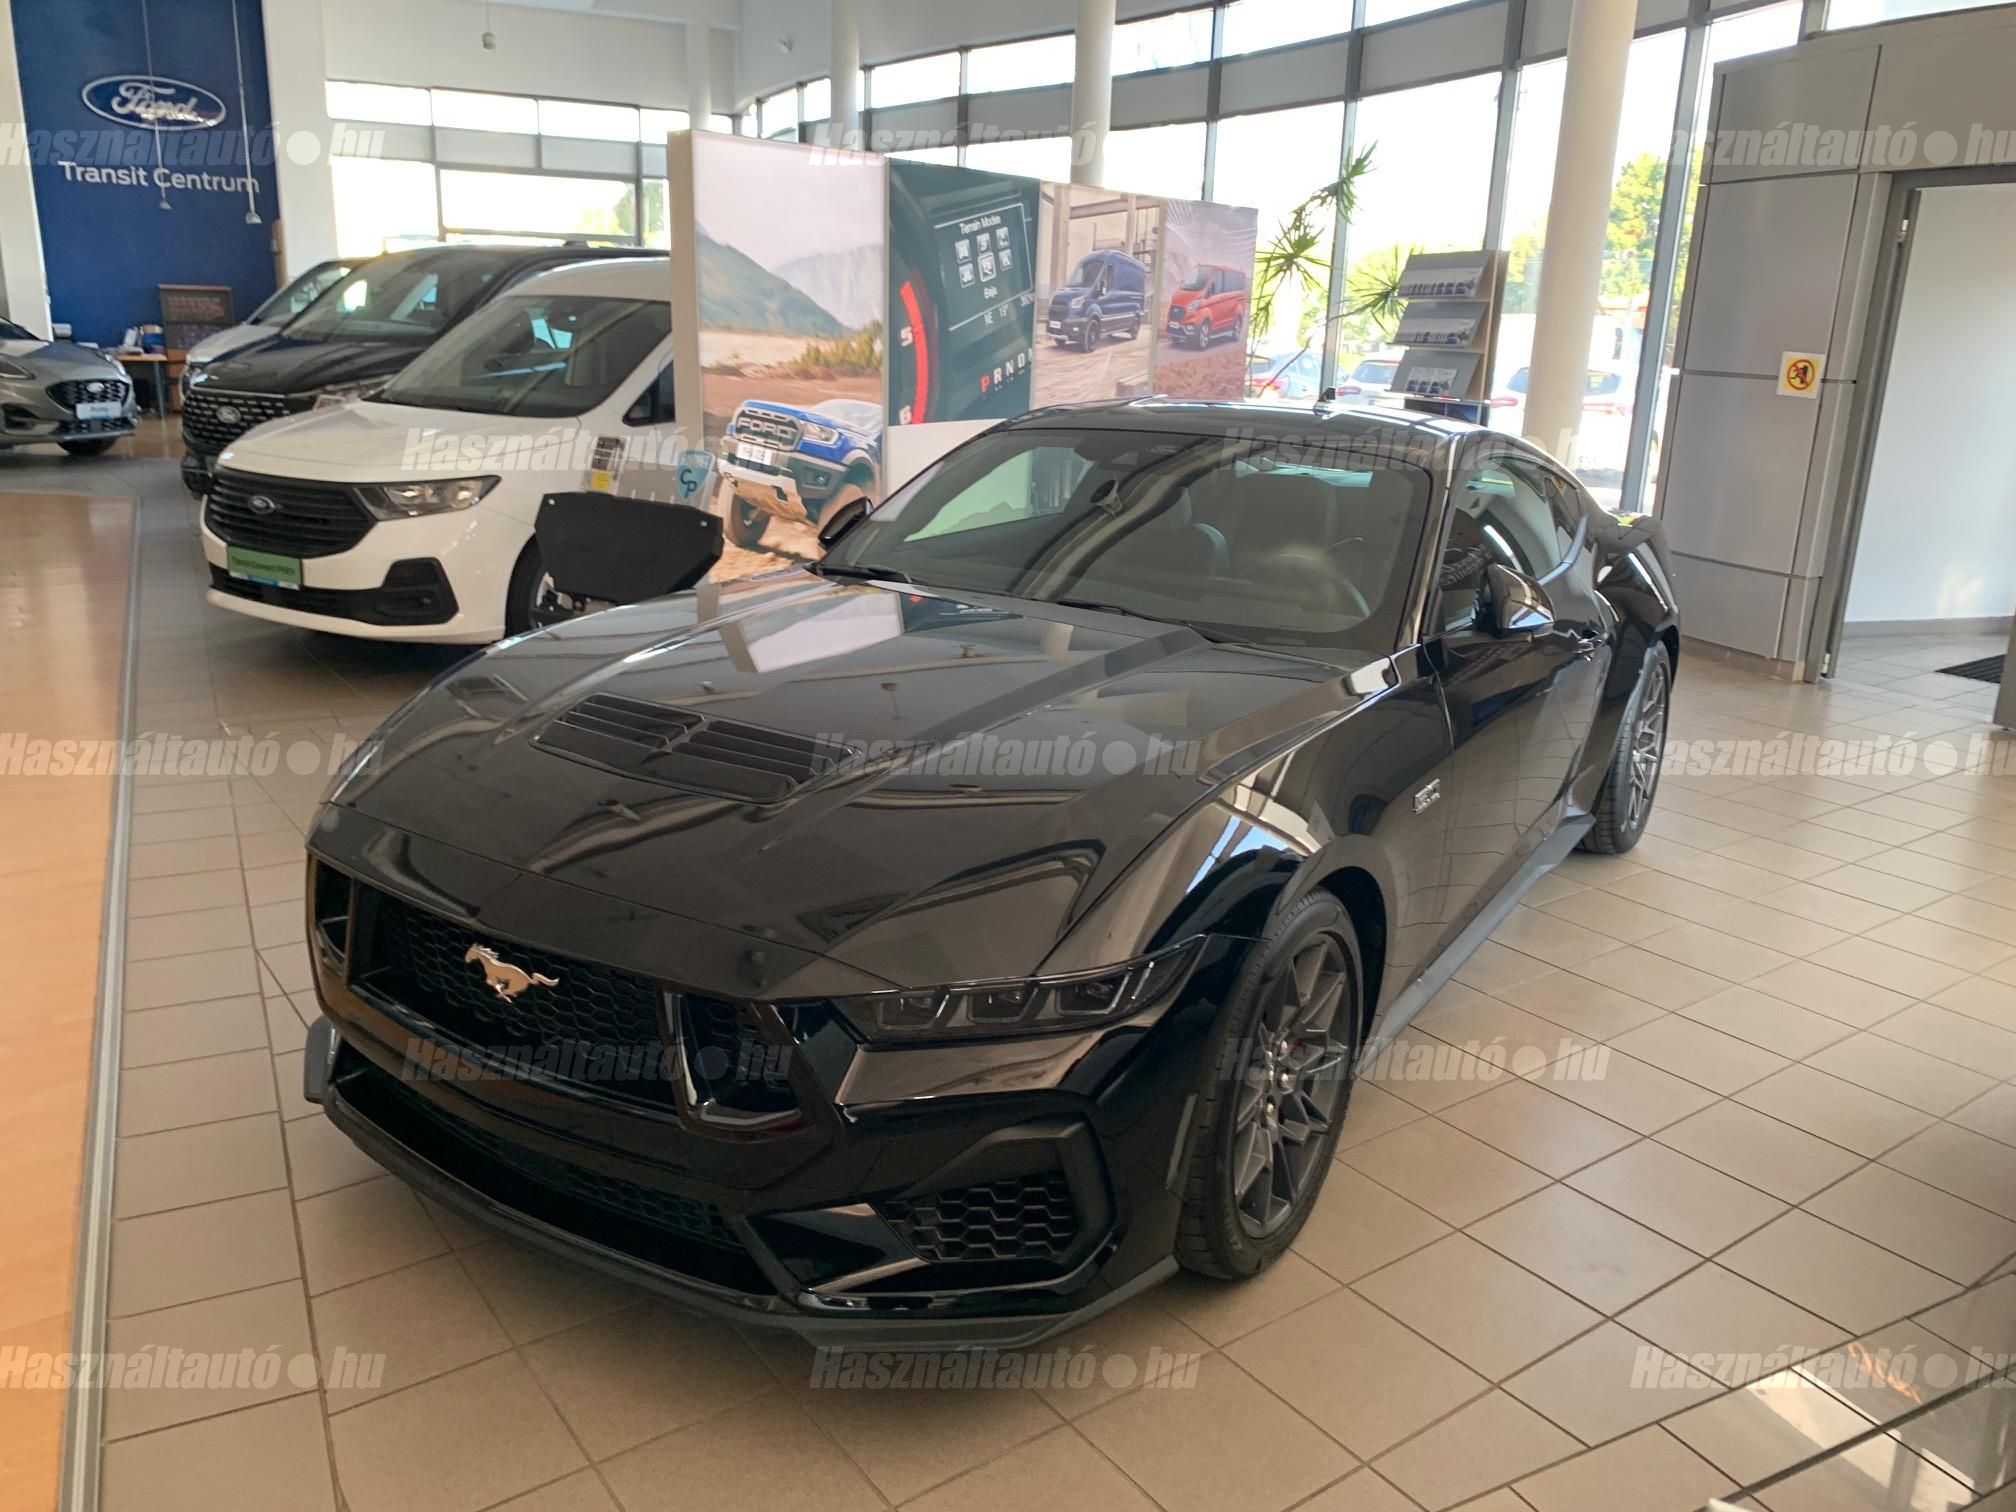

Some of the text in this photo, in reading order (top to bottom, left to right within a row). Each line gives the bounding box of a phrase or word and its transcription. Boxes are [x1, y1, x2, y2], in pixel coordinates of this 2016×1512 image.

[111, 82, 199, 122] Ford
[57, 159, 261, 194] Transit Centrum
[900, 326, 913, 347] 5
[737, 415, 793, 440] FORD
[899, 405, 912, 425] 6
